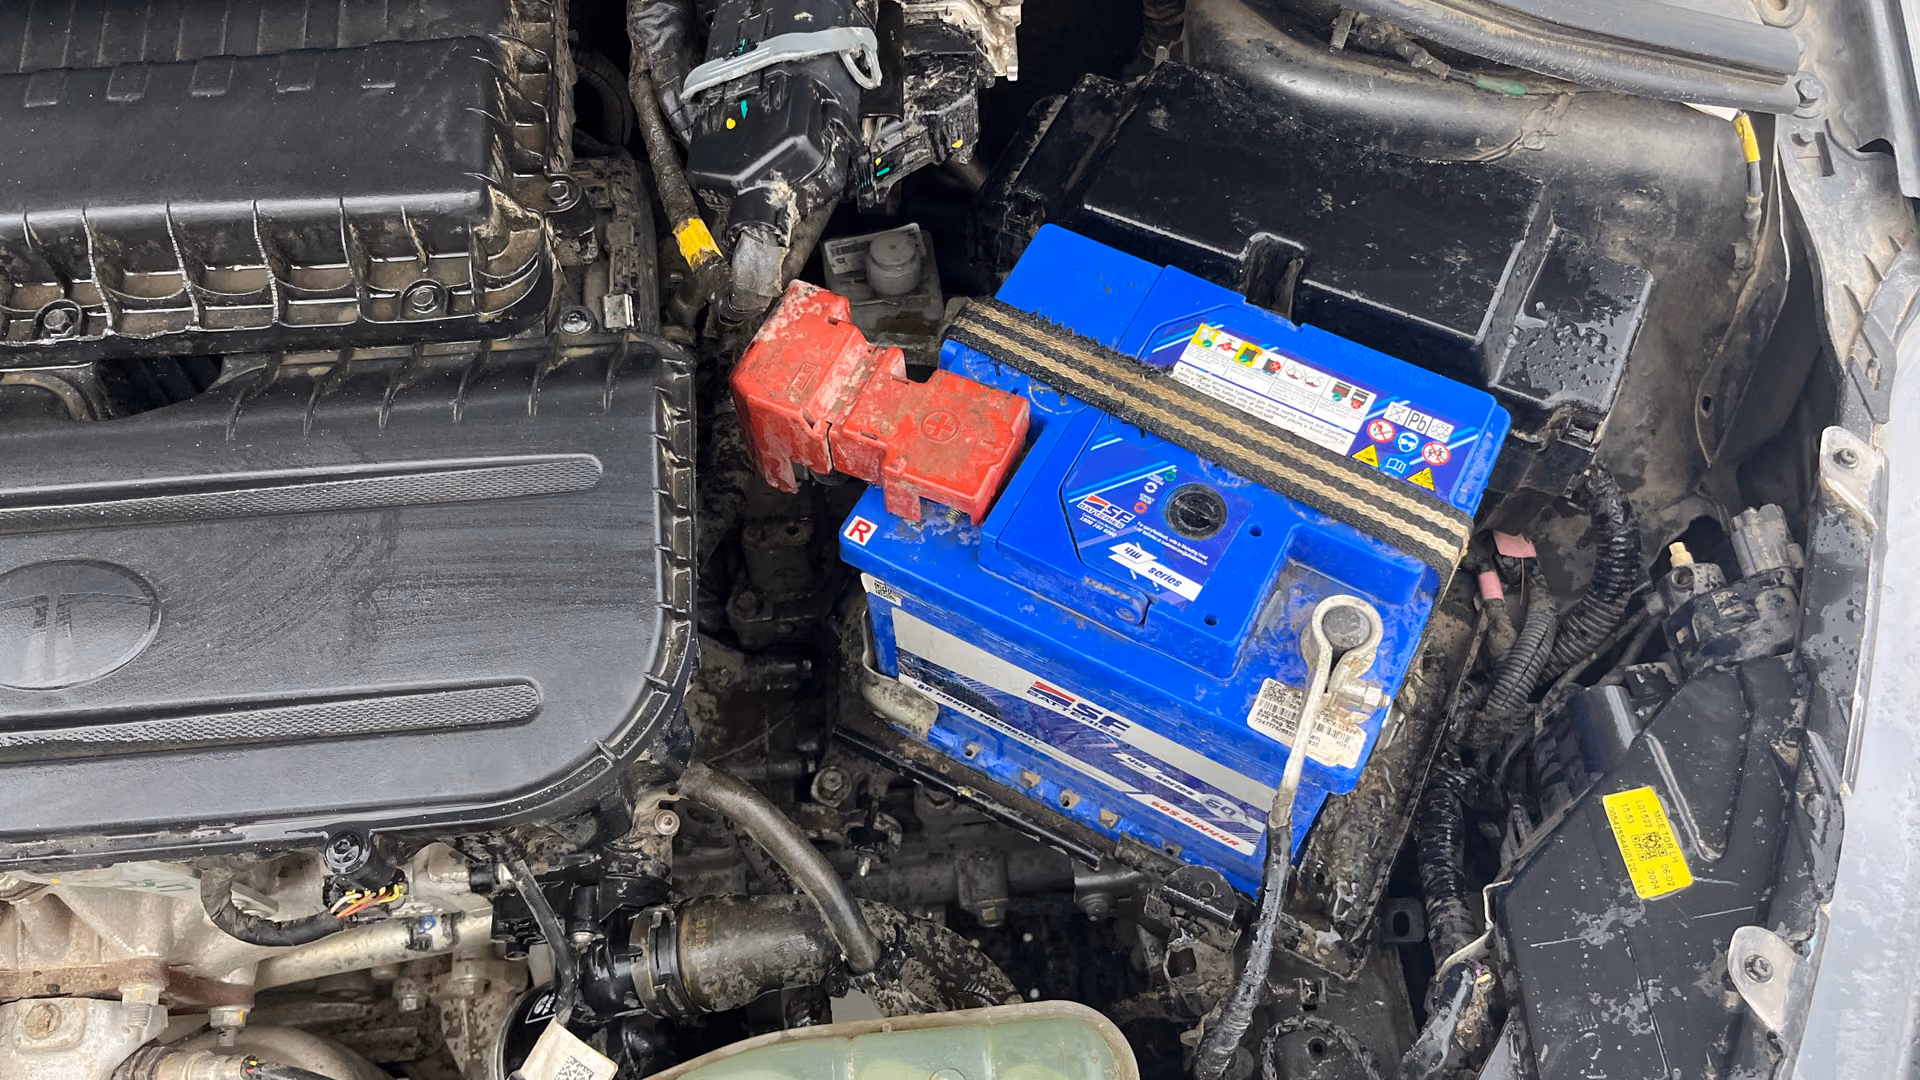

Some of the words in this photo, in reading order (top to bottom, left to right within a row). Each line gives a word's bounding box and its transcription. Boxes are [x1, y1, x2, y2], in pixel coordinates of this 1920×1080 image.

[1408, 412, 1427, 431] Pb
[1078, 503, 1125, 529] BATTERIES
[1105, 505, 1133, 523] SF
[849, 519, 871, 543] R
[1148, 566, 1182, 588] series
[936, 692, 976, 713] MONTH
[980, 713, 1042, 745] WARRANTY
[1026, 689, 1121, 738] BATTERIES
[1070, 701, 1130, 731] SF
[1155, 775, 1195, 796] series
[1205, 798, 1236, 817] 60
[1669, 852, 1679, 863] LH
[1648, 870, 1660, 890] 2024
